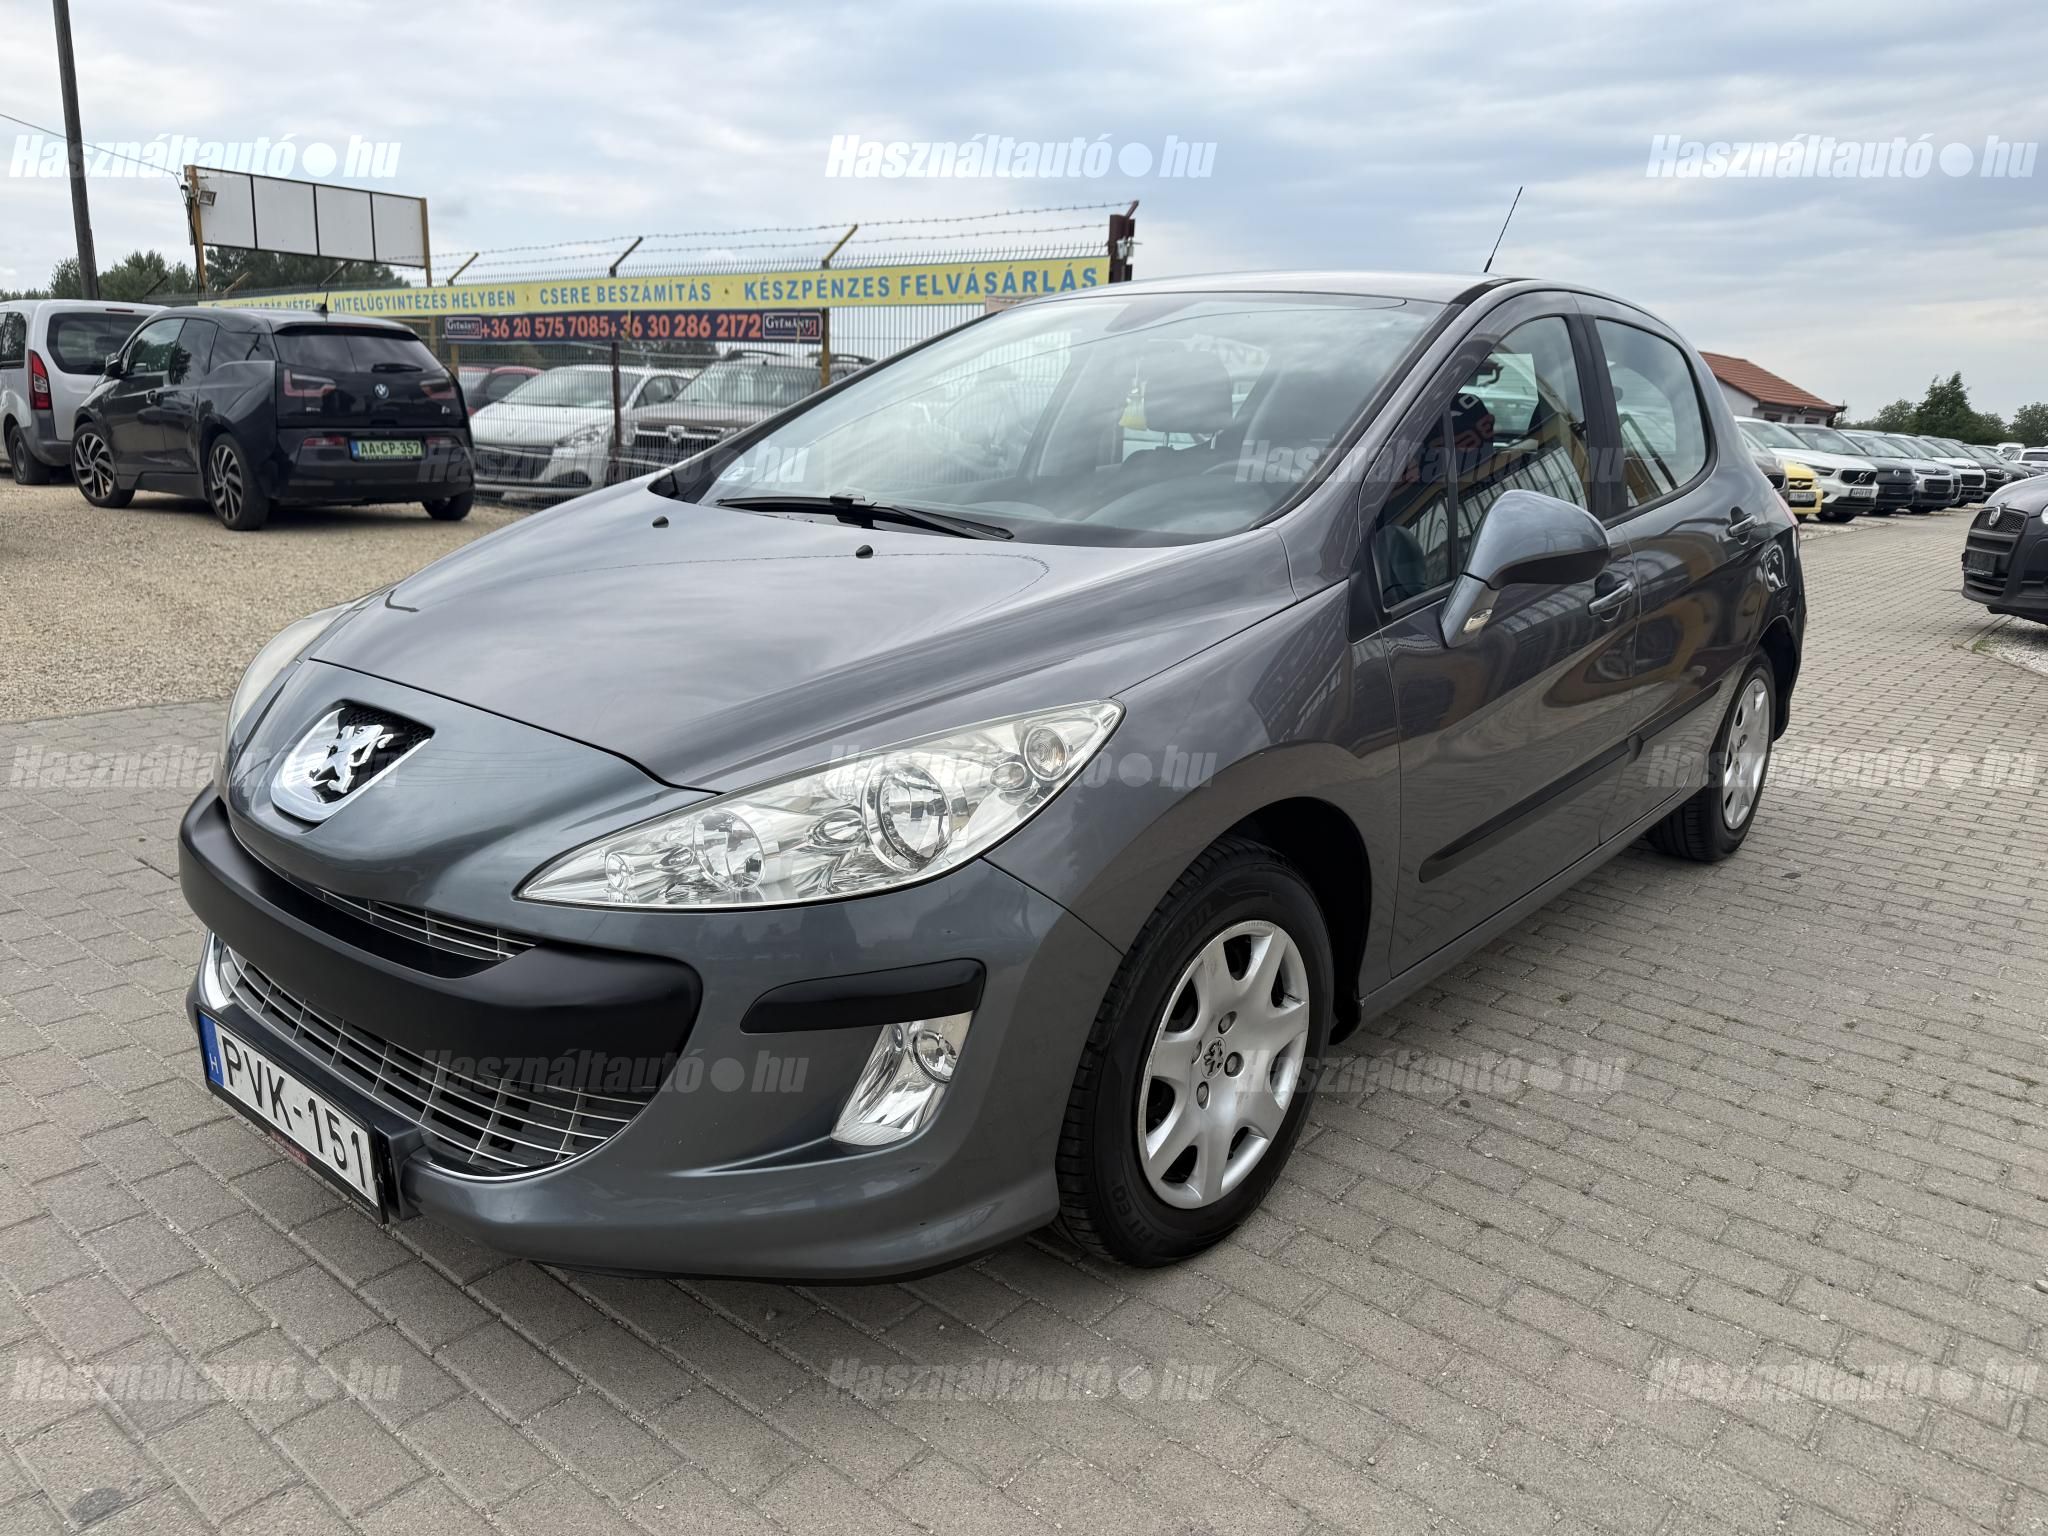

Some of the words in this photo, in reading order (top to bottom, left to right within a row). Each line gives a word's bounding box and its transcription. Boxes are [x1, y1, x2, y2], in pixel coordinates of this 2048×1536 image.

[452, 289, 516, 309] HELYBEN
[540, 286, 591, 305] CSERE
[597, 278, 711, 303] BESZÁMÍTÁS
[744, 274, 890, 301] KÉSZPÉNZES
[901, 263, 1097, 297] FELVÁSÁRLÁS
[481, 318, 509, 338] +36
[513, 317, 531, 338] 20
[534, 316, 564, 338] 575
[567, 315, 609, 338] 7085
[647, 314, 670, 338] 30
[674, 314, 711, 338] 286
[716, 313, 762, 338] 2172
[221, 1034, 367, 1189] PVK-151
